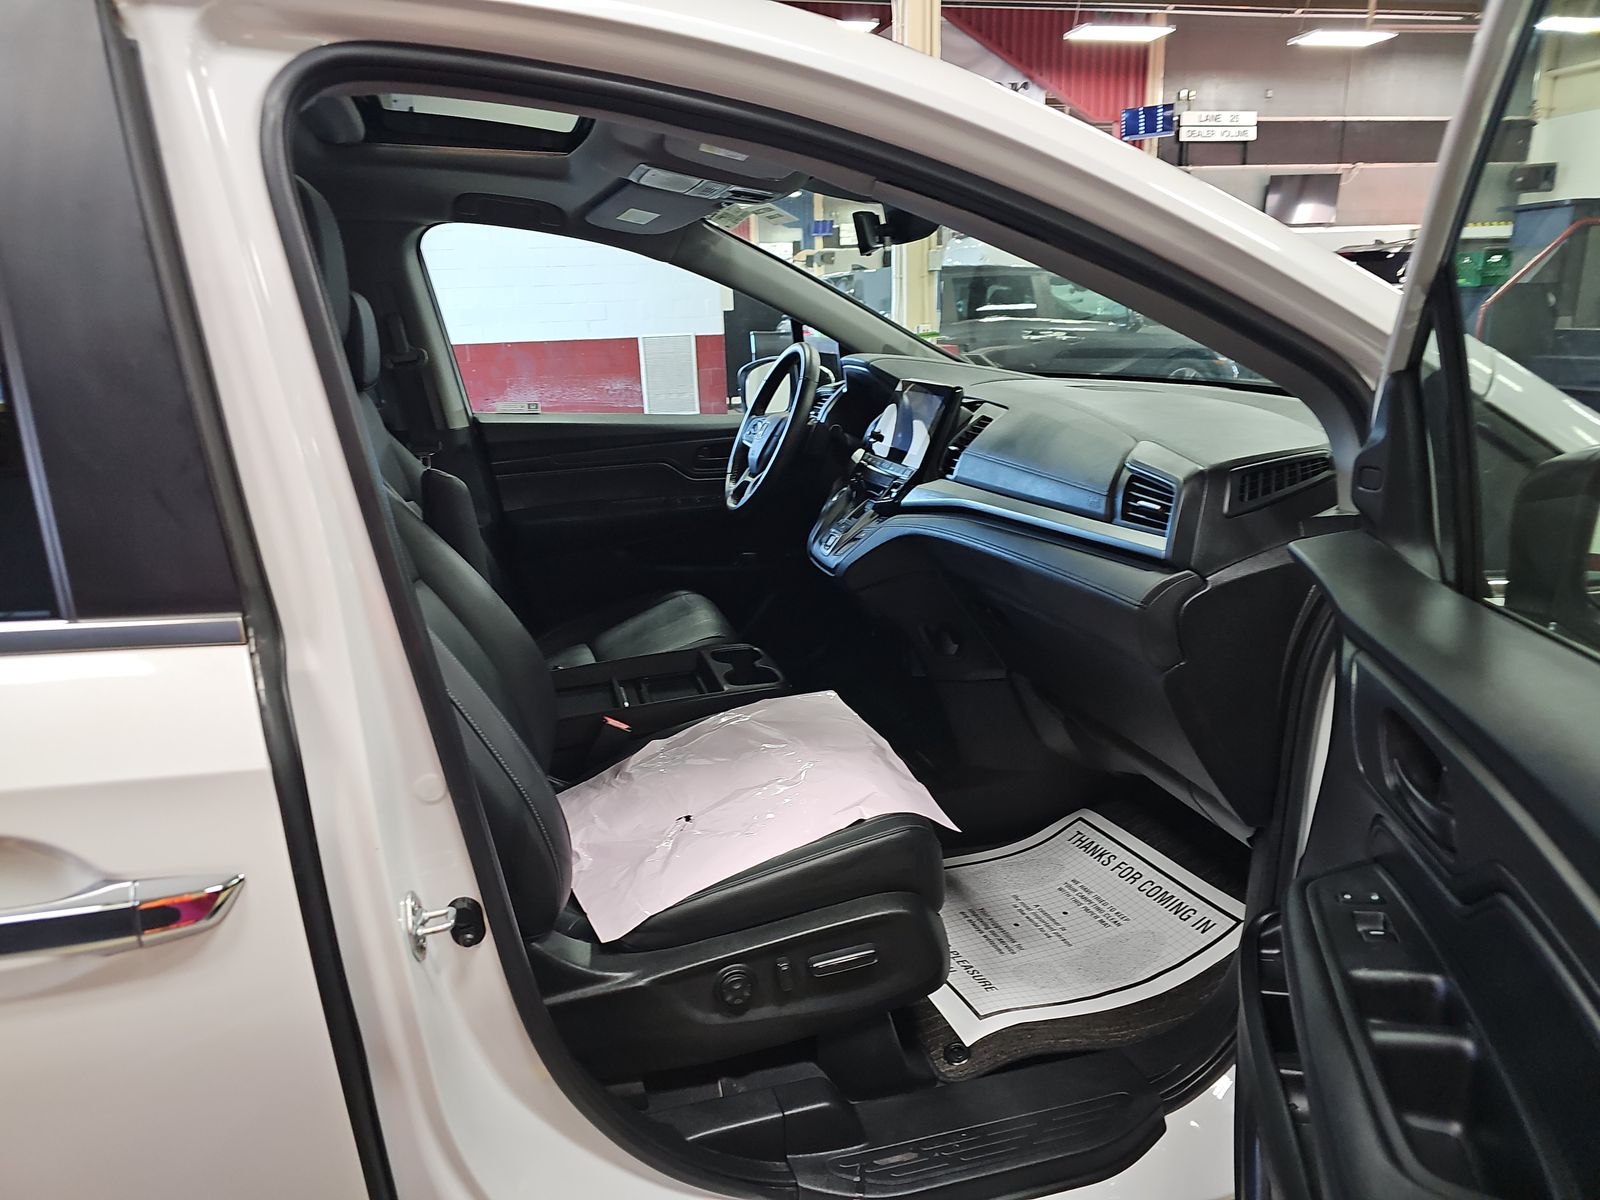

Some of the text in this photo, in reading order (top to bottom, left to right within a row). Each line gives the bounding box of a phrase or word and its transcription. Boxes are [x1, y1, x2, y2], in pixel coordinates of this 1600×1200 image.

[1198, 114, 1222, 123] LANE
[1186, 129, 1249, 138] DEALER VOLUME
[1067, 830, 1217, 935] THANKS FOR COMING IN
[1114, 911, 1132, 921] KEEP
[1098, 919, 1111, 928] MAT
[950, 950, 999, 992] PLEASURE
